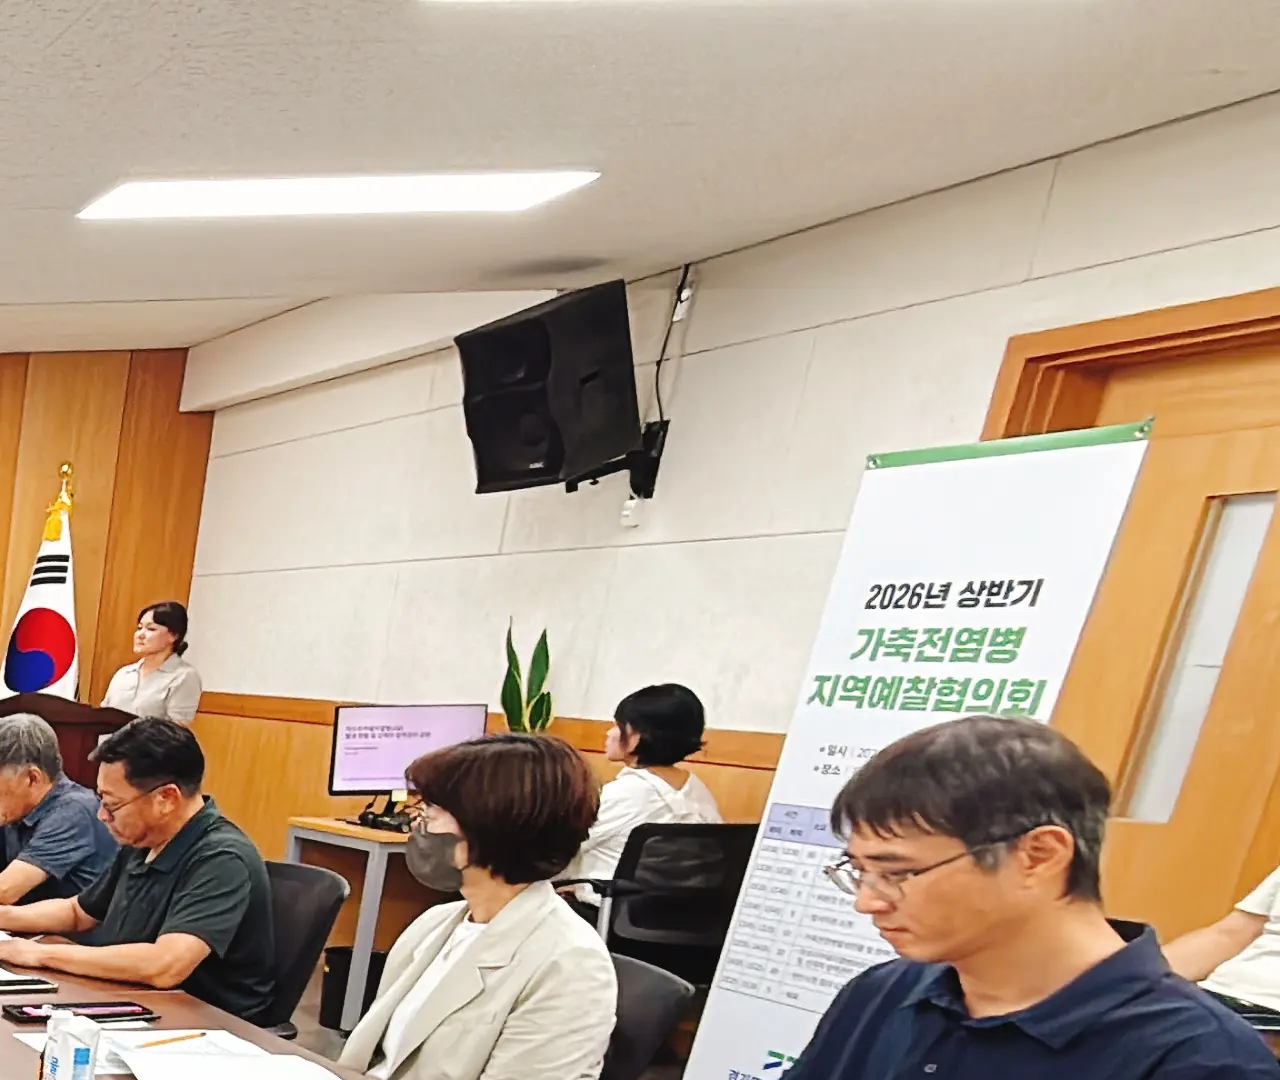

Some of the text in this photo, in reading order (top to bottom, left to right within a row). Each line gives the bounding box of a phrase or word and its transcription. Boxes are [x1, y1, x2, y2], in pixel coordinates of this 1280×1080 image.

[864, 577, 1045, 611] 2026년 상반기
[849, 625, 1028, 665] 가축전염병
[806, 673, 1048, 717] 지역예찰협의회
[827, 745, 848, 757] 일시
[821, 764, 841, 775] 장소
